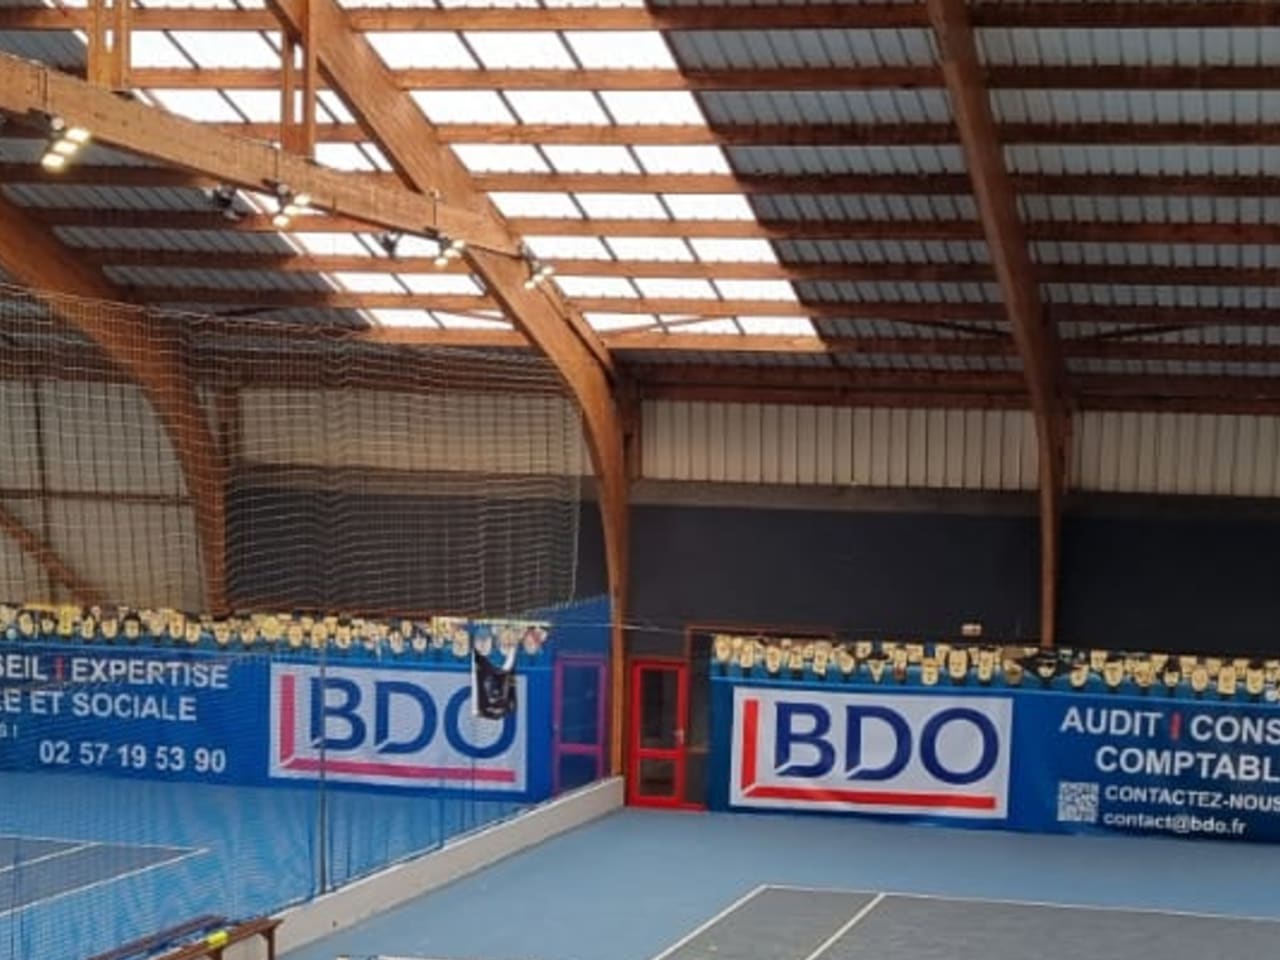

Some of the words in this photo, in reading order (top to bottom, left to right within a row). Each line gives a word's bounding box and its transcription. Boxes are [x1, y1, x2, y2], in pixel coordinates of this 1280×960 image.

[71, 658, 229, 689] EXPERTISE
[30, 690, 64, 714] ET
[72, 692, 197, 721] SOCIALE
[310, 677, 517, 759] BDO
[1060, 707, 1163, 737] AUDIT
[39, 740, 70, 764] 02
[80, 742, 109, 765] 57
[118, 744, 147, 769] 19
[155, 746, 186, 771] 53
[194, 748, 226, 773] 90
[774, 702, 1000, 785] BDO
[1103, 812, 1247, 835] contact@bdo.fr
